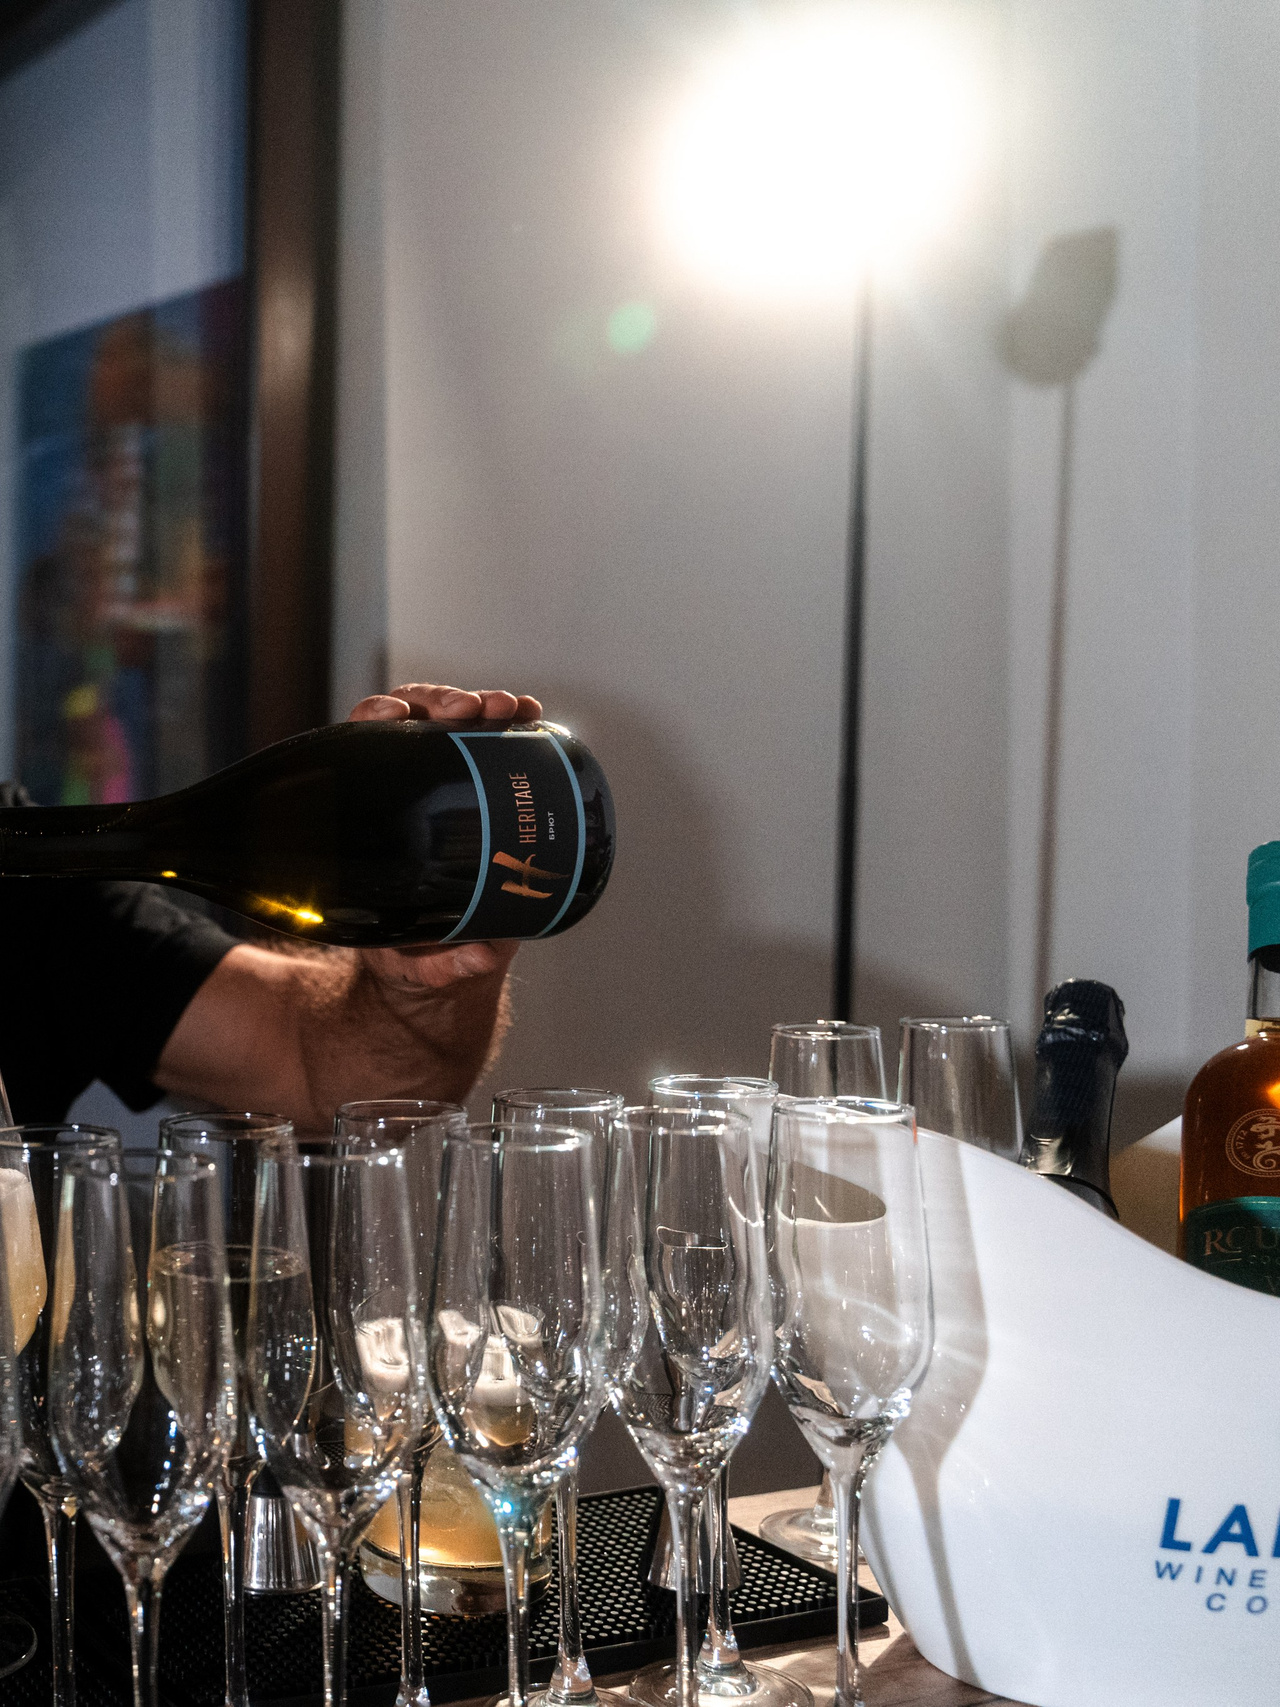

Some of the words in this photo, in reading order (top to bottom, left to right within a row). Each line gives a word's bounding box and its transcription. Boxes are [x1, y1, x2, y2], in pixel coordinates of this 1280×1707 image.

[509, 772, 536, 843] HERITAGE
[1235, 1129, 1248, 1150] 1772
[1159, 1497, 1280, 1558] LA
[1155, 1560, 1267, 1588] WINE
